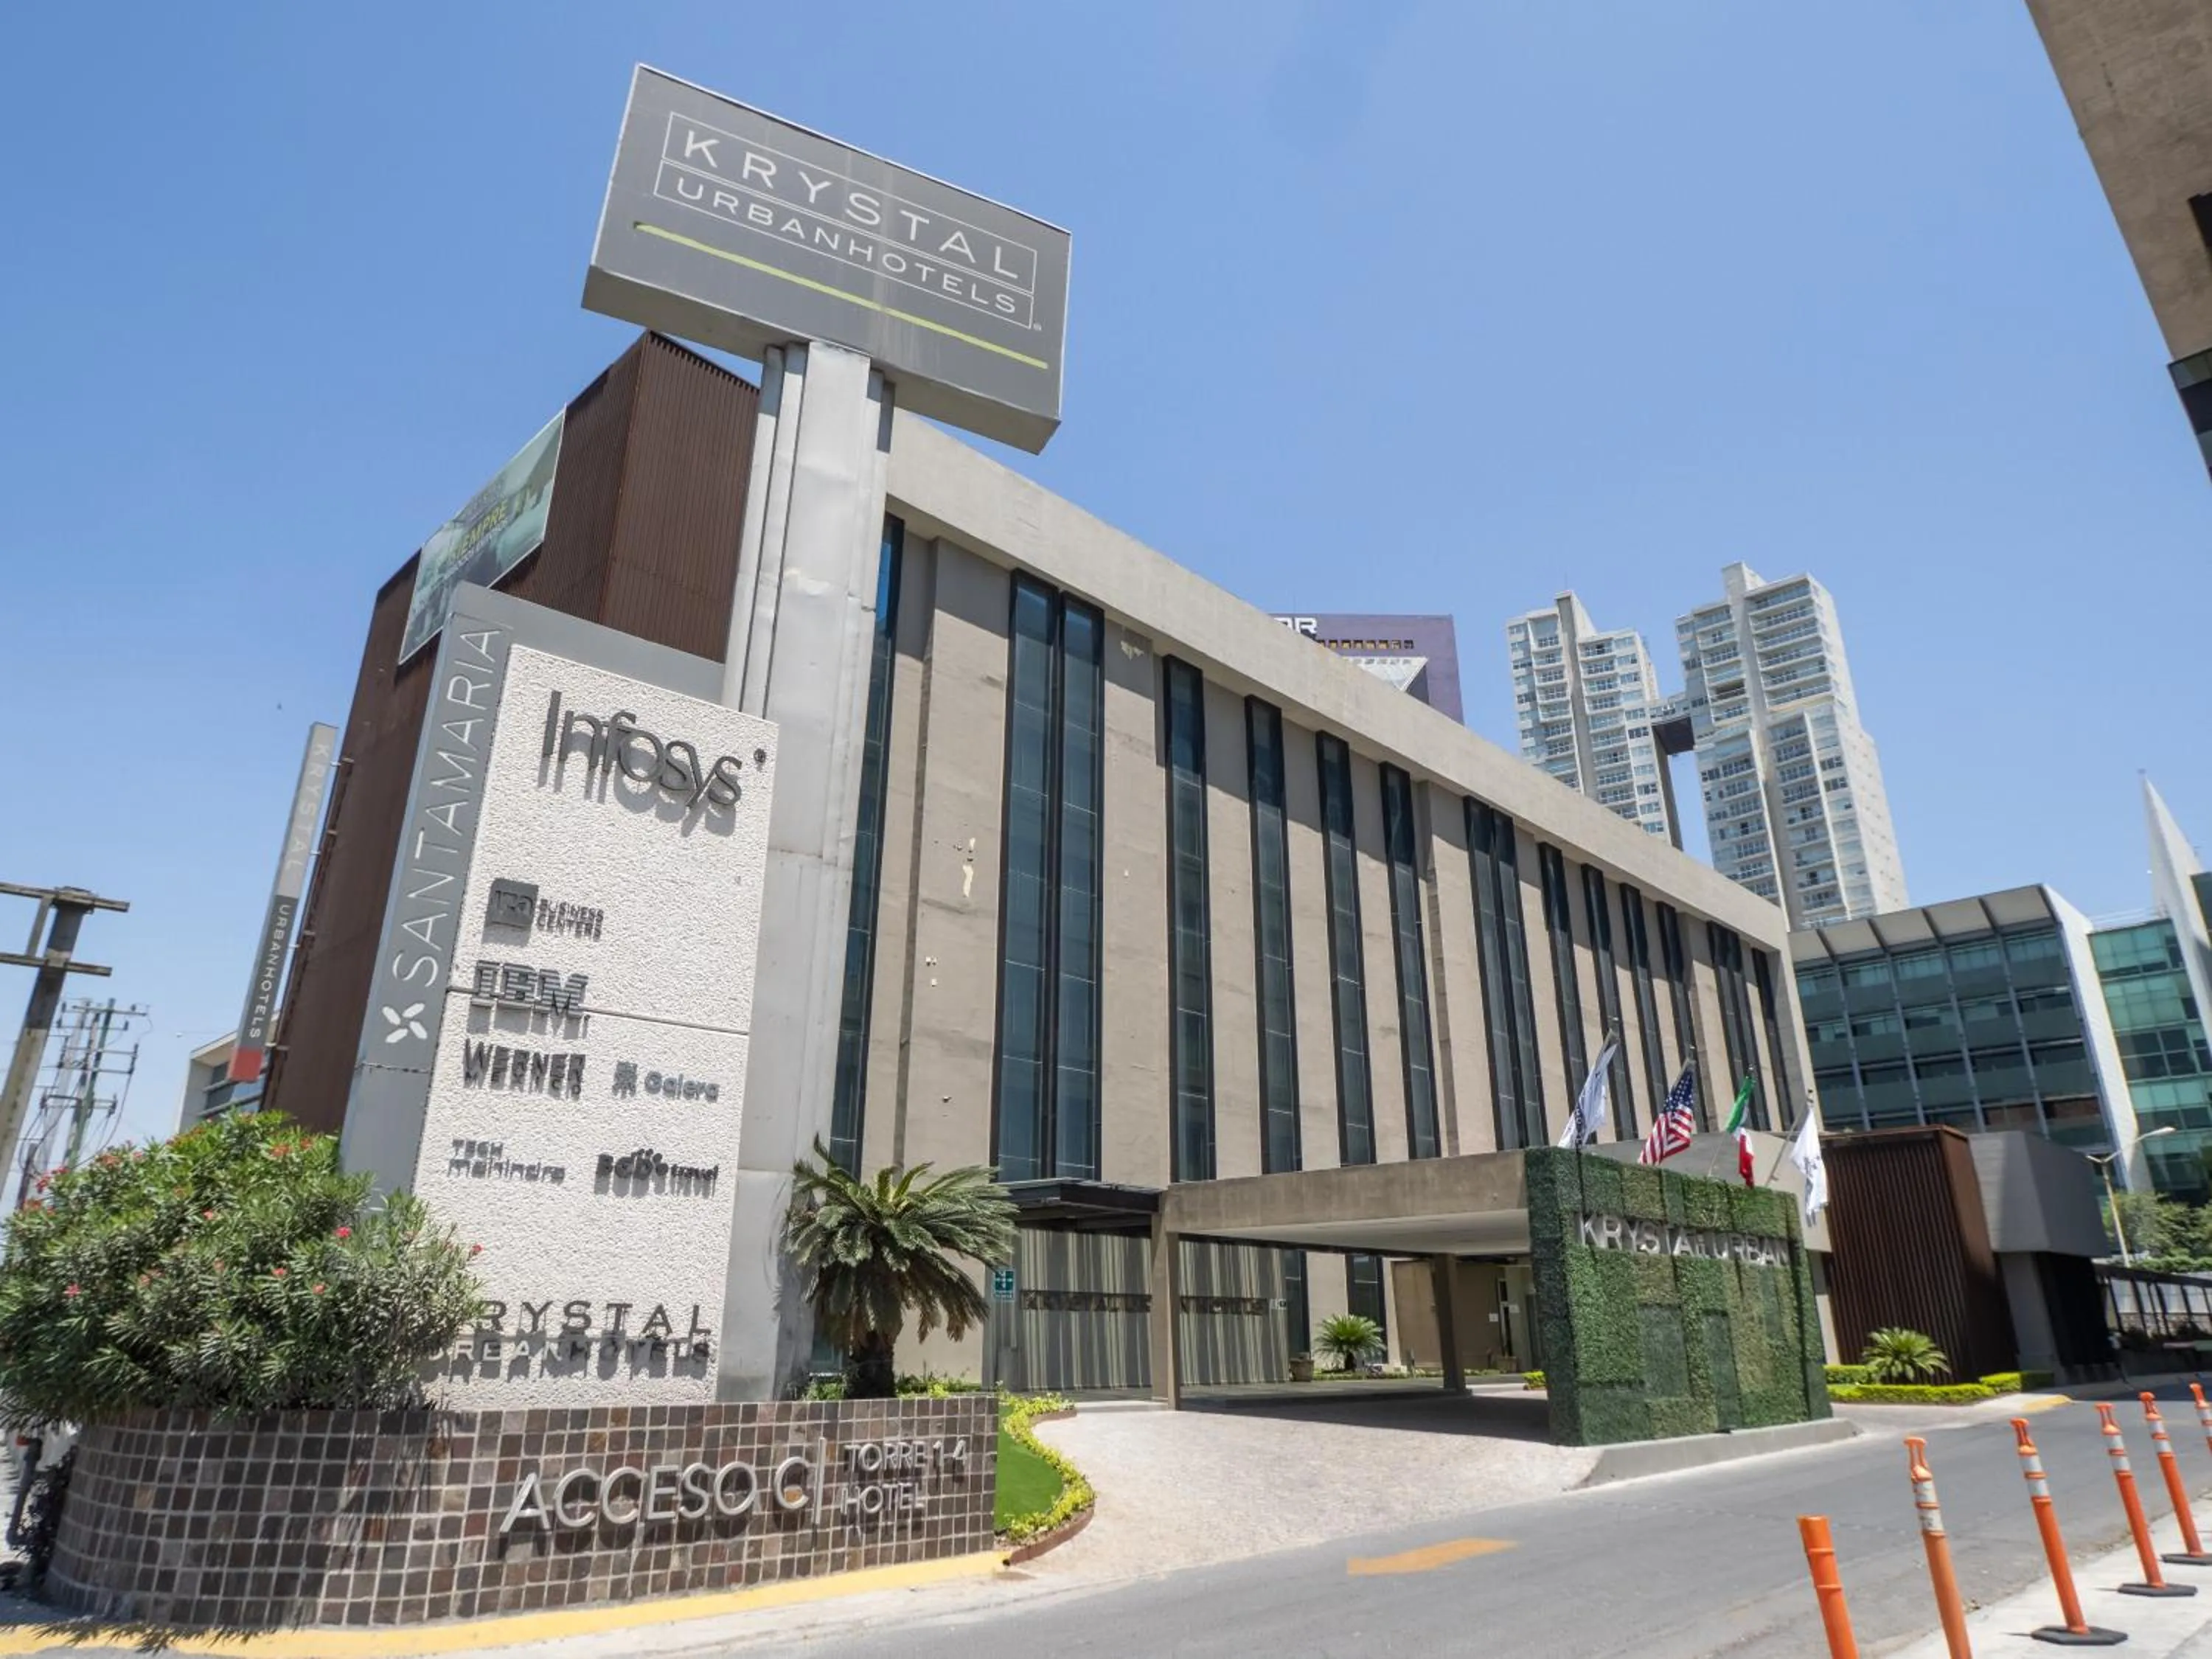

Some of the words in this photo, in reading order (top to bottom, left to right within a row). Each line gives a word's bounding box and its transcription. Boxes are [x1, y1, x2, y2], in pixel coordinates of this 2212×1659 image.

[683, 129, 1019, 280] KRYSTAL
[541, 689, 743, 810] Infosys
[285, 743, 330, 871] KRYSTAL
[392, 627, 502, 988] SANTAMARIA
[536, 914, 602, 939] CENTERS
[538, 898, 605, 922] BUSINESS
[471, 959, 590, 1018] IBM
[452, 1138, 504, 1160] TECH
[477, 1299, 712, 1338] RYSTAL
[844, 1439, 927, 1472] TORRE
[499, 1459, 758, 1534] ACCESO
[773, 1455, 810, 1510] C
[839, 1482, 925, 1515] HOTEL
